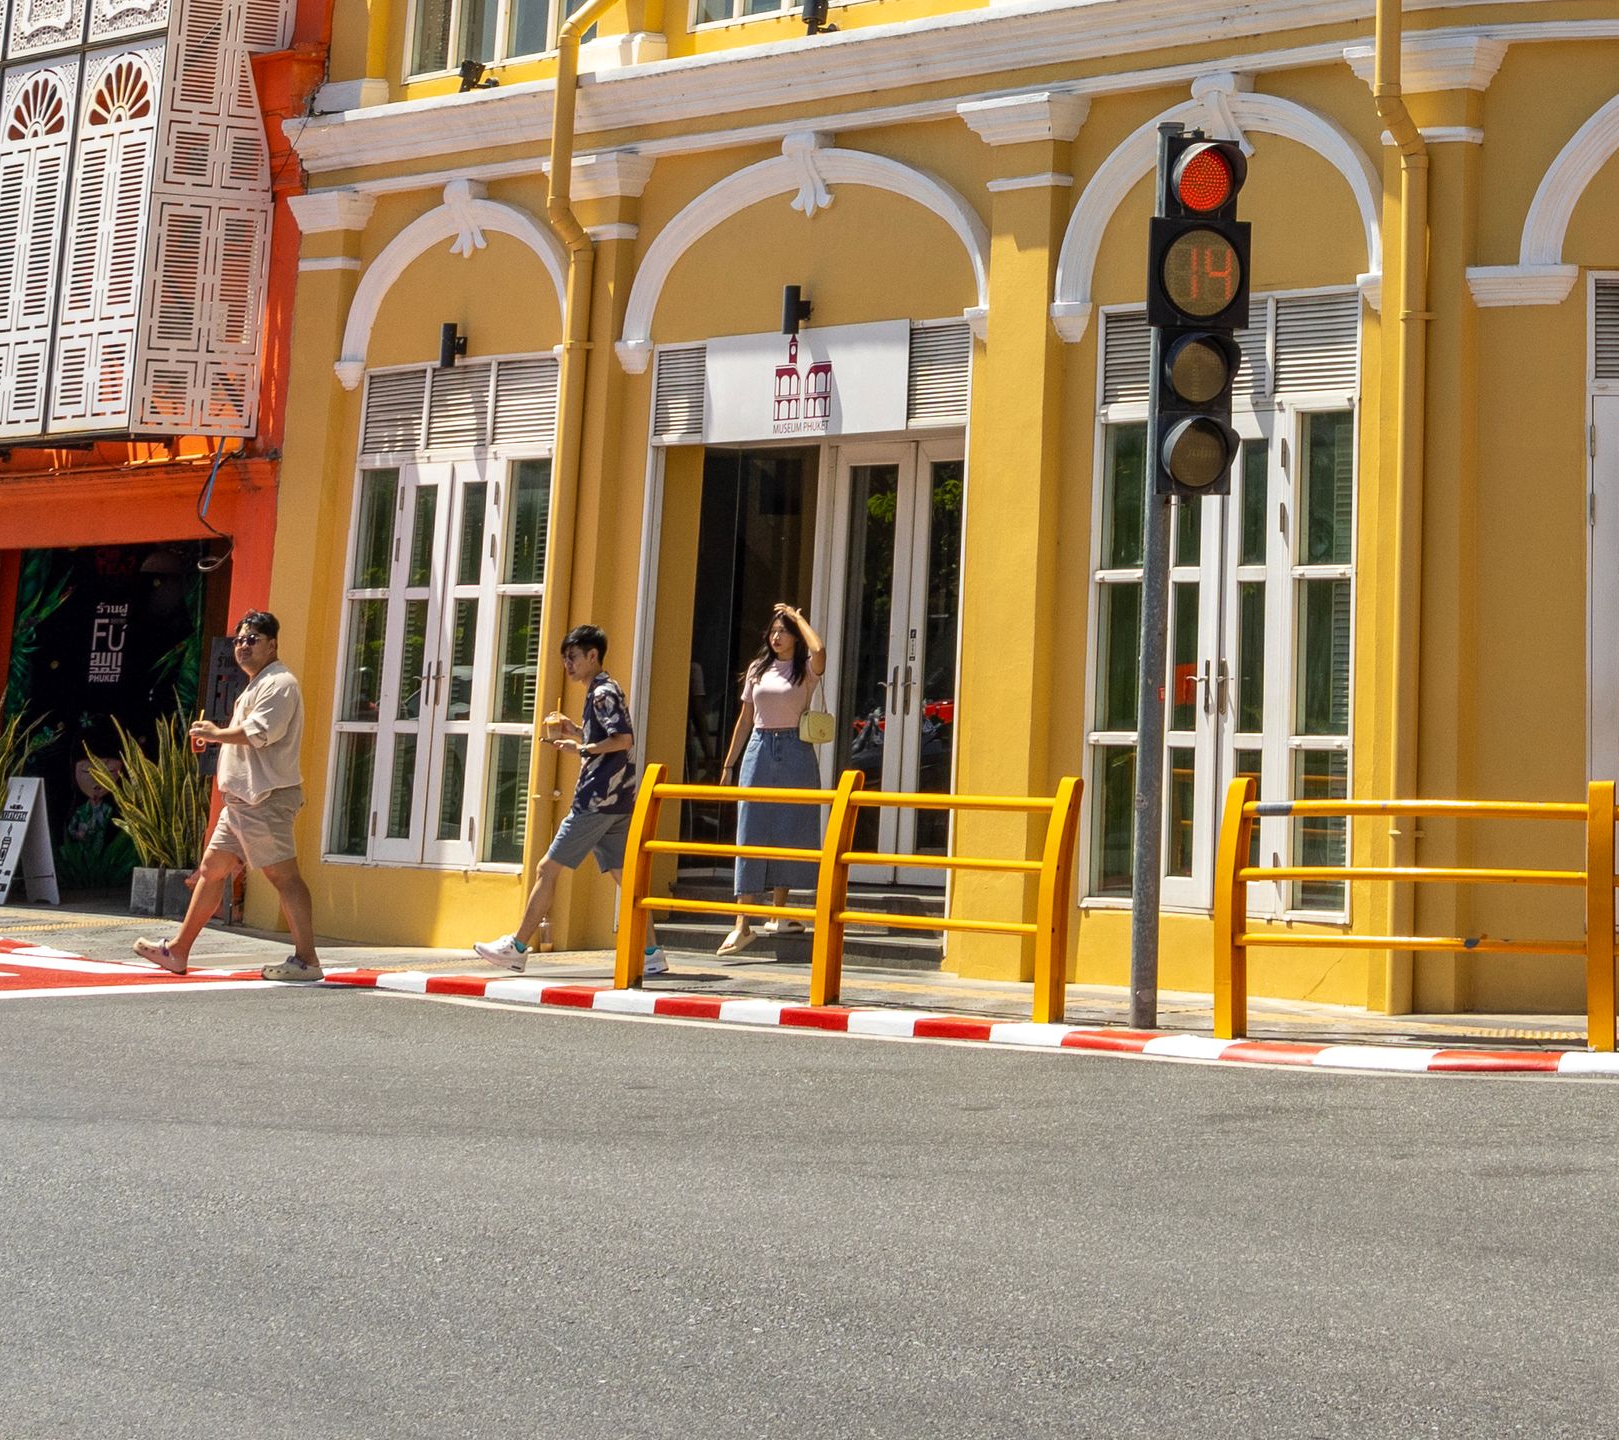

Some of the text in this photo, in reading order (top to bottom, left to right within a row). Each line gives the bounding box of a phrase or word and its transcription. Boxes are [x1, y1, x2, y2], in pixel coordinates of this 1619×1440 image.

[1191, 248, 1232, 301] 14
[773, 420, 829, 434] MUSEUM PHUKET
[89, 674, 120, 683] PHUKET
